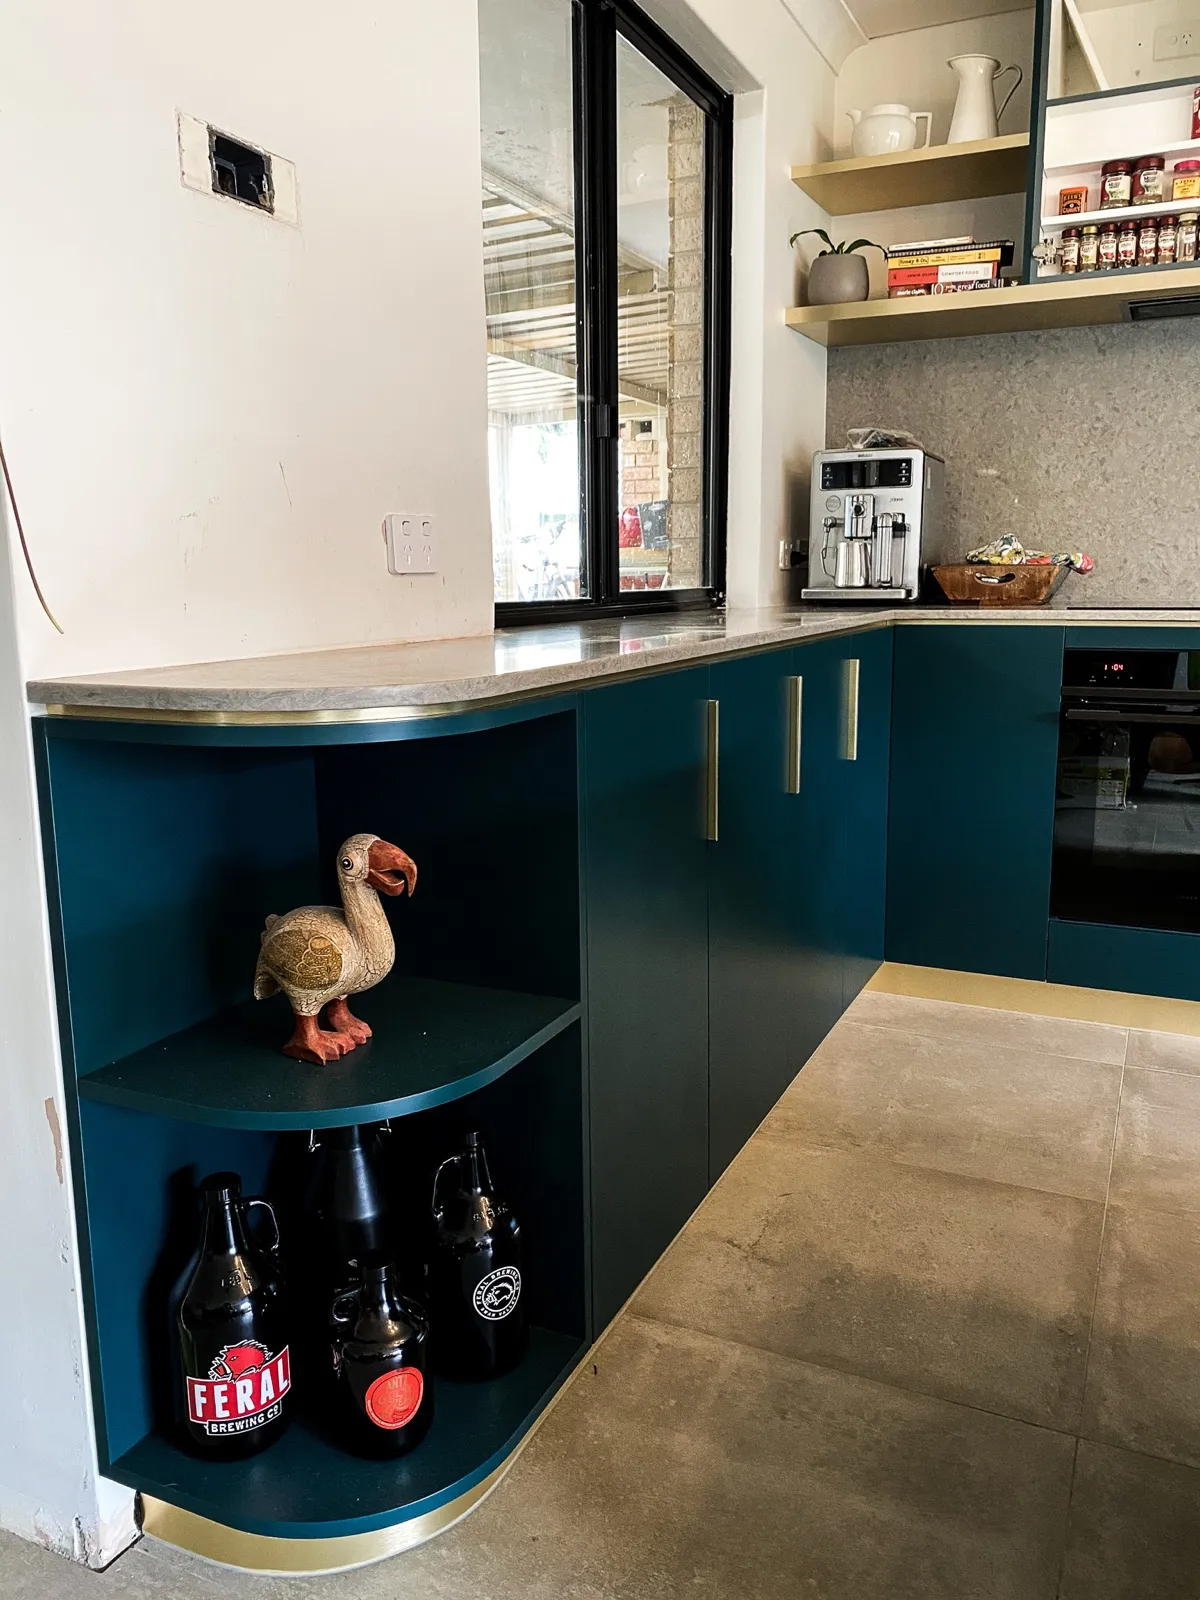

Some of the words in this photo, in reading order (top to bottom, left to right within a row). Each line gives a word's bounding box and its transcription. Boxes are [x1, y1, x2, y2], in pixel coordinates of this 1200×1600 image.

[975, 279, 990, 289] food
[476, 1281, 489, 1306] FERAL
[490, 1268, 519, 1280] BREWING
[194, 1359, 289, 1419] FERAL
[211, 1413, 265, 1433] BREWING
